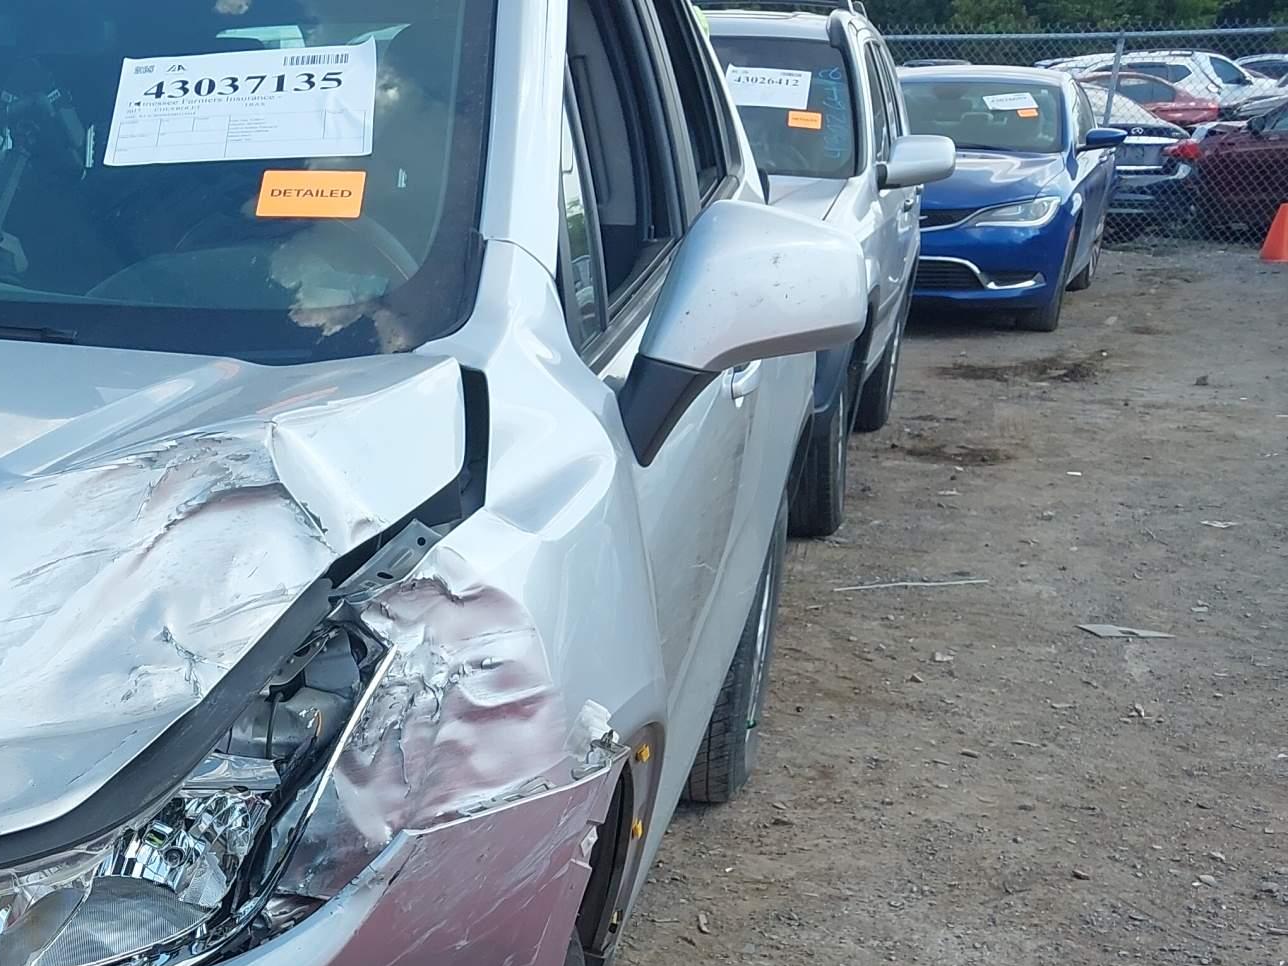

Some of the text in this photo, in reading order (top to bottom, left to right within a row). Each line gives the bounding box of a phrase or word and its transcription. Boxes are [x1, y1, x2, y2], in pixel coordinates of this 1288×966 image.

[143, 71, 344, 99] 43037135
[734, 76, 800, 87] 43026412
[226, 95, 275, 103] Insurance
[269, 187, 353, 199] DETAILED
